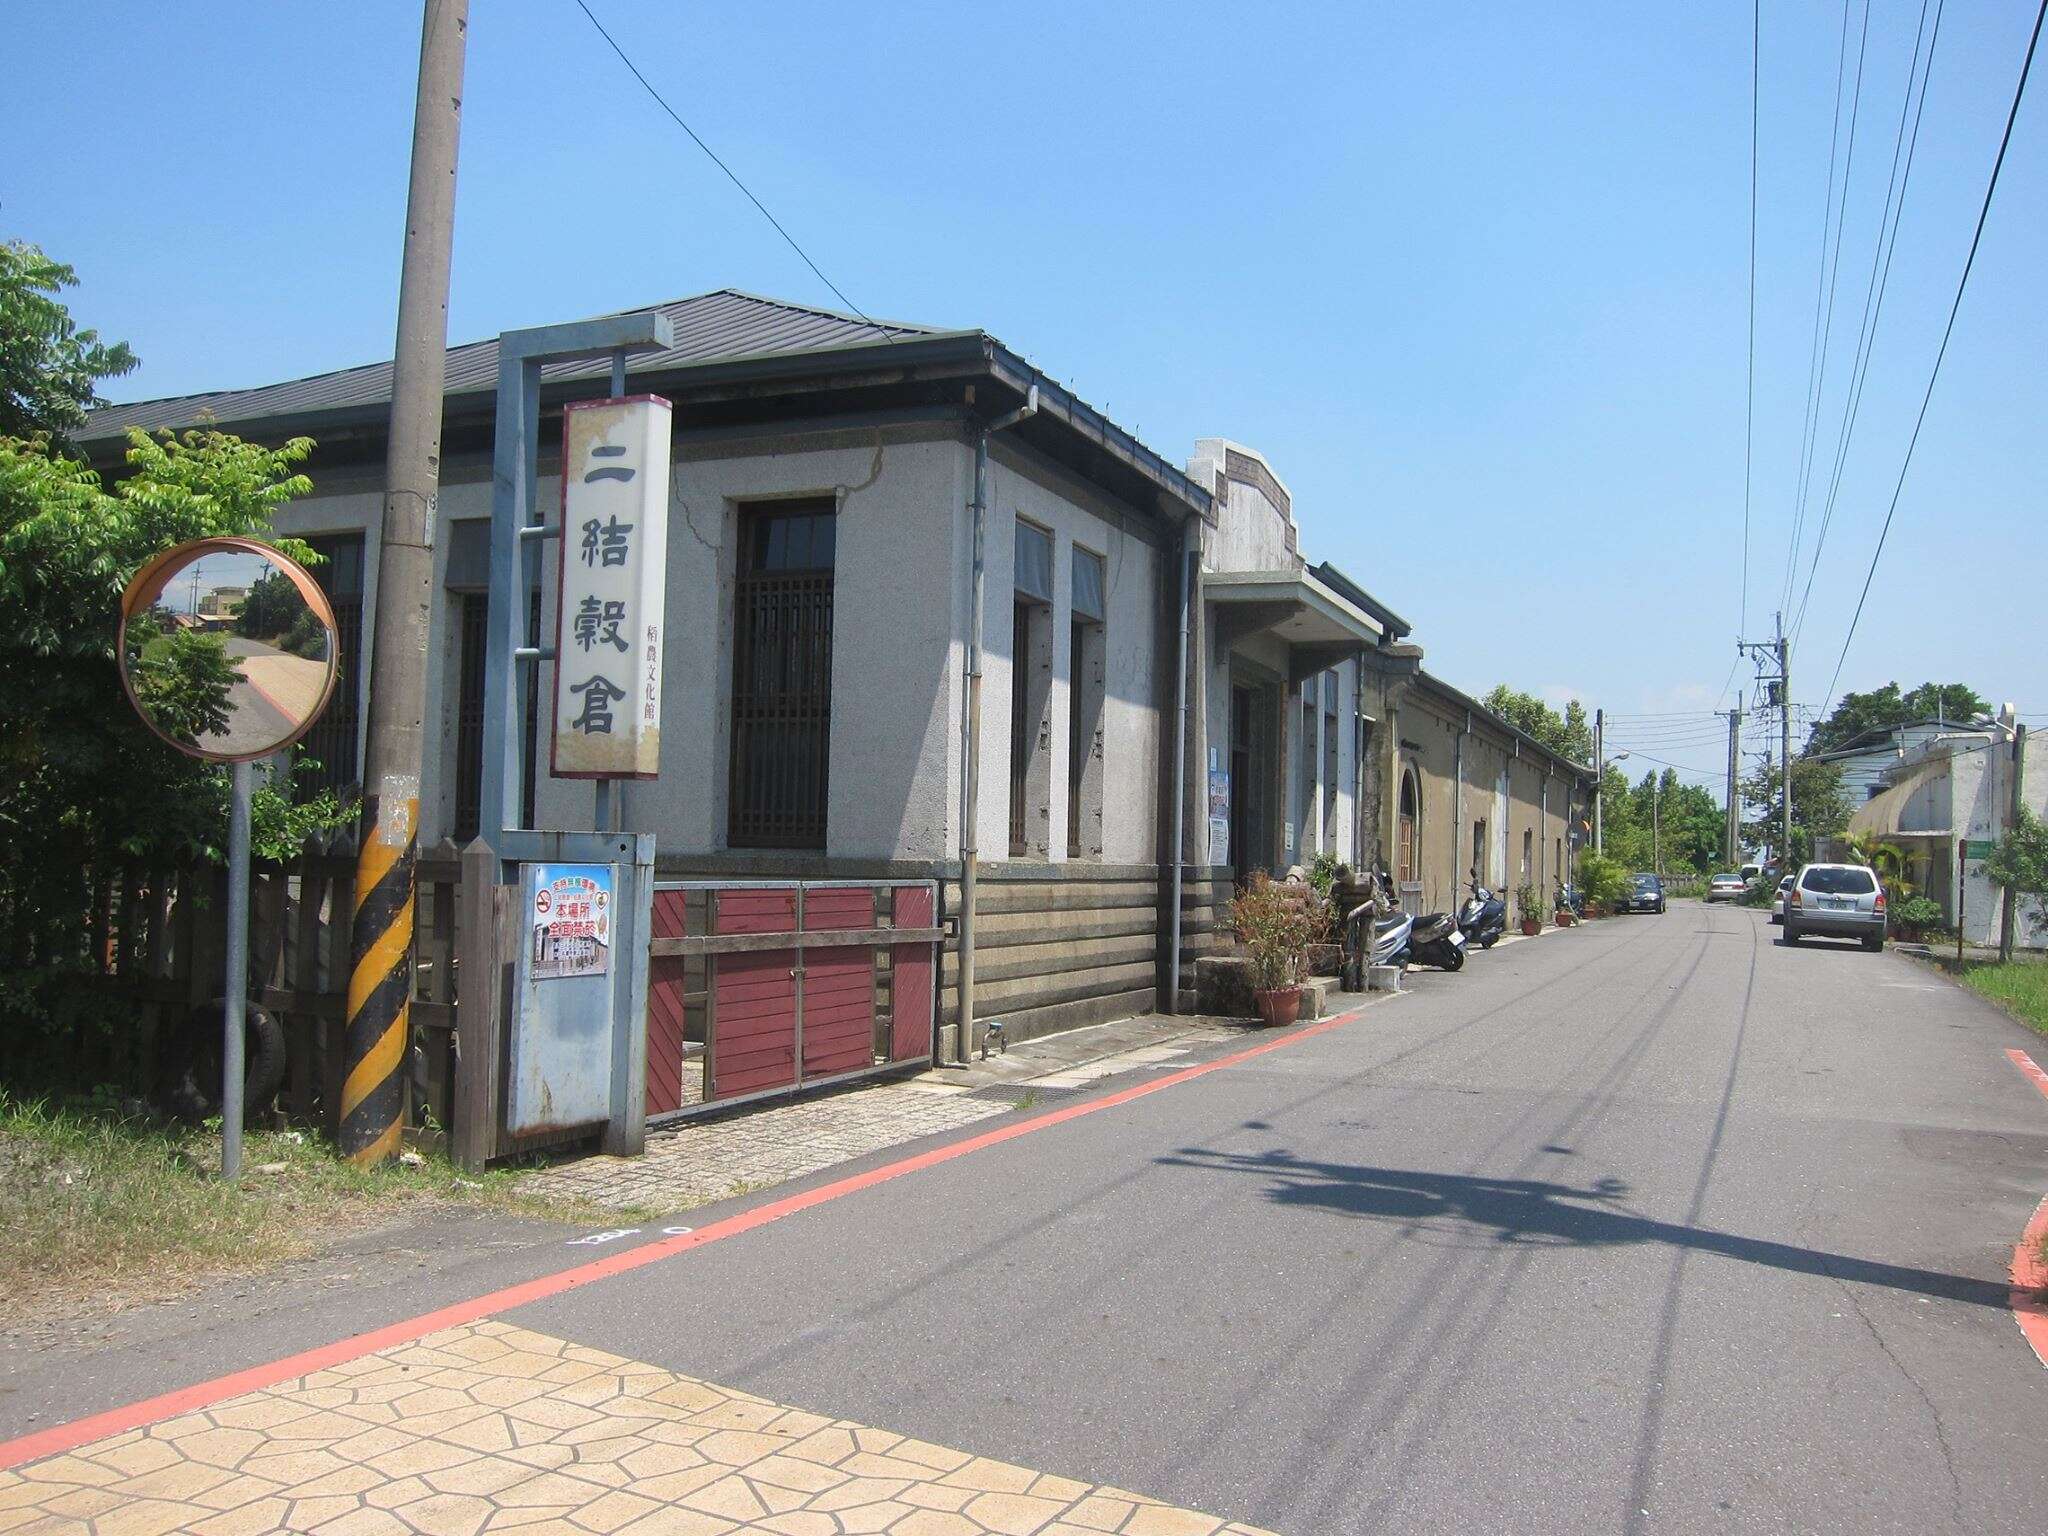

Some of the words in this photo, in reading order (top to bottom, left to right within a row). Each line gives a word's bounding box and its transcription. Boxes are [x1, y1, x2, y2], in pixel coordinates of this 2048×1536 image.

[570, 445, 636, 735] 二結穀倉
[643, 624, 658, 720] 稻農文化館
